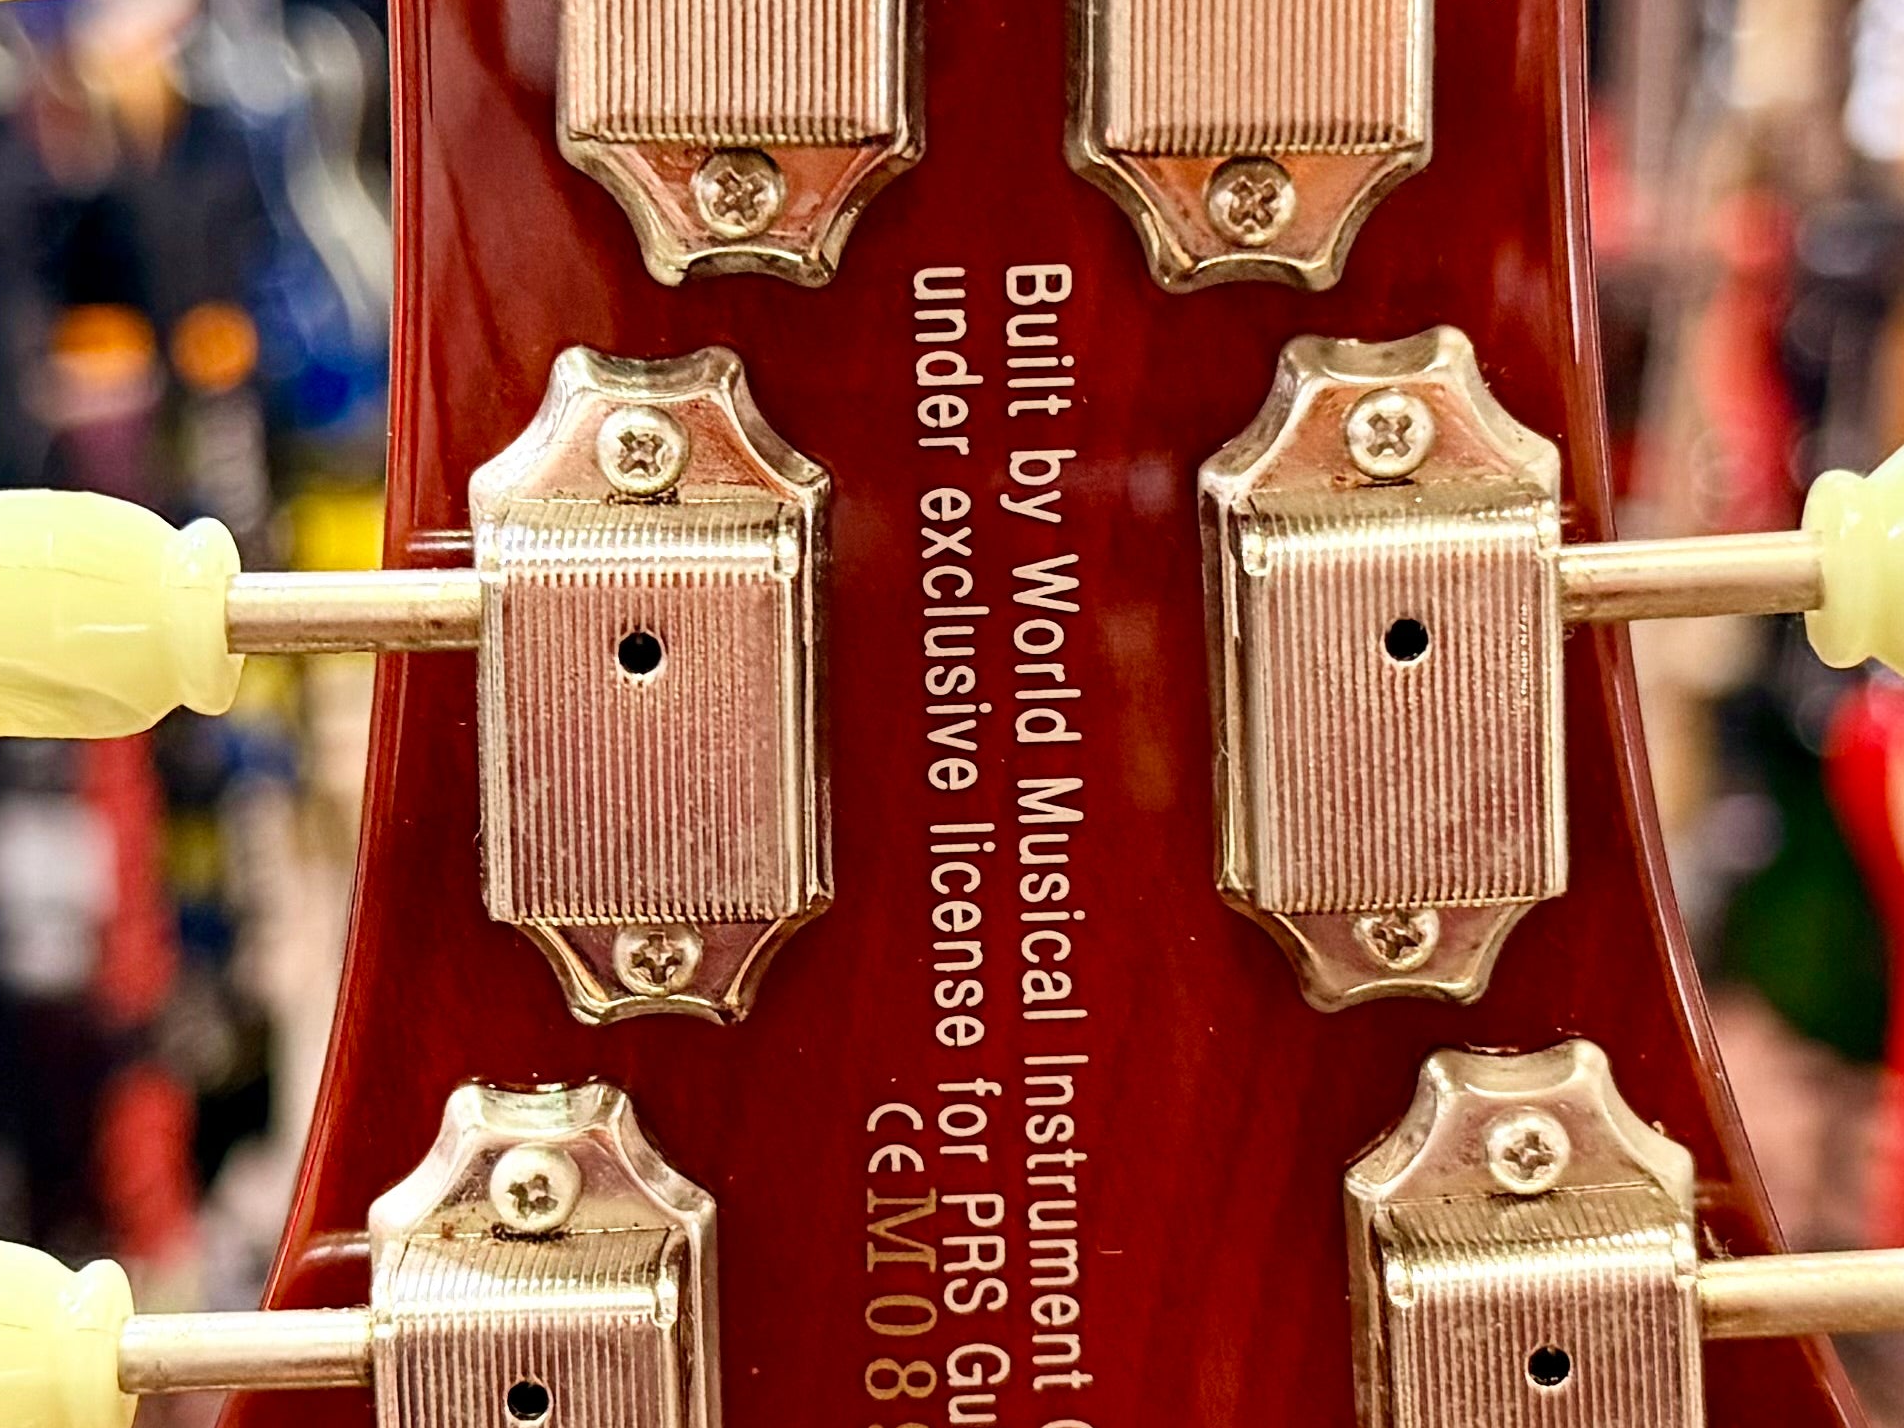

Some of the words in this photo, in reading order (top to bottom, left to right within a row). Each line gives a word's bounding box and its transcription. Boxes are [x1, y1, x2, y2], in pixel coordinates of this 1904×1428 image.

[911, 265, 985, 457] under
[1004, 262, 1077, 419] Built
[998, 447, 1078, 525] by
[918, 486, 994, 792] exclusive
[1010, 552, 1084, 744] World
[928, 821, 998, 1048] license
[1015, 776, 1090, 1021] Musical
[936, 1076, 1004, 1164] for
[939, 1192, 1010, 1315] PRS
[1022, 1053, 1095, 1392] Instrument
